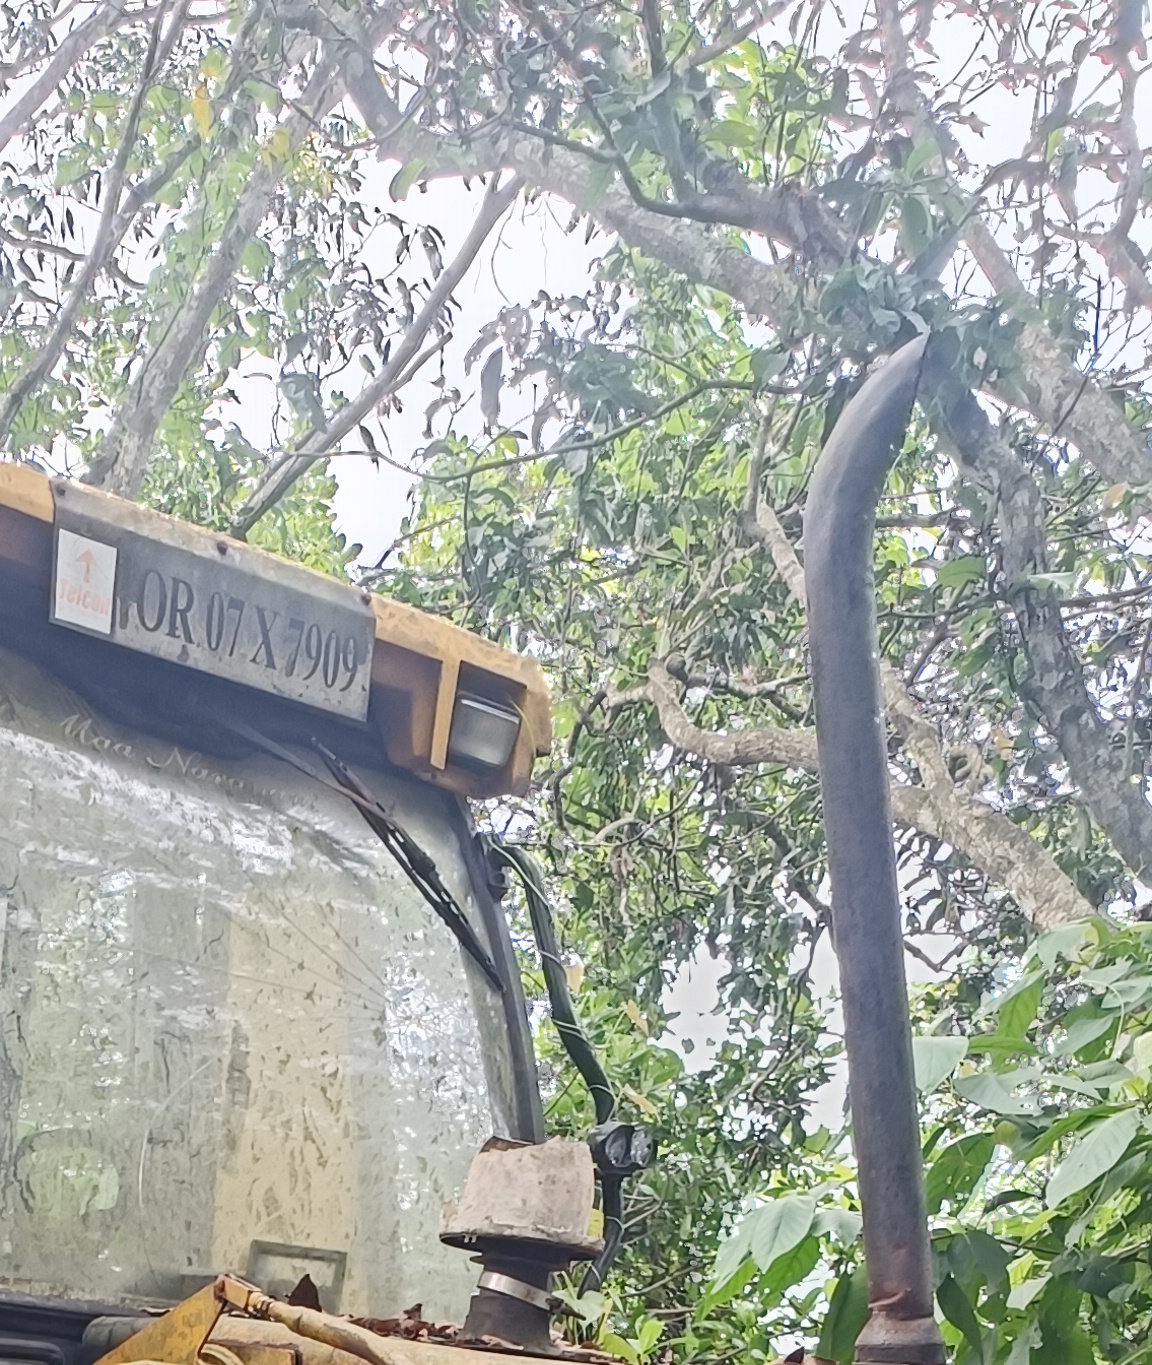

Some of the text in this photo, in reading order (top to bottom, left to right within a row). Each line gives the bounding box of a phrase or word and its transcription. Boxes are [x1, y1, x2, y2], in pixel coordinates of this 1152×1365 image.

[136, 569, 359, 692] OR 07 X 7909
[59, 713, 134, 757] Maa
